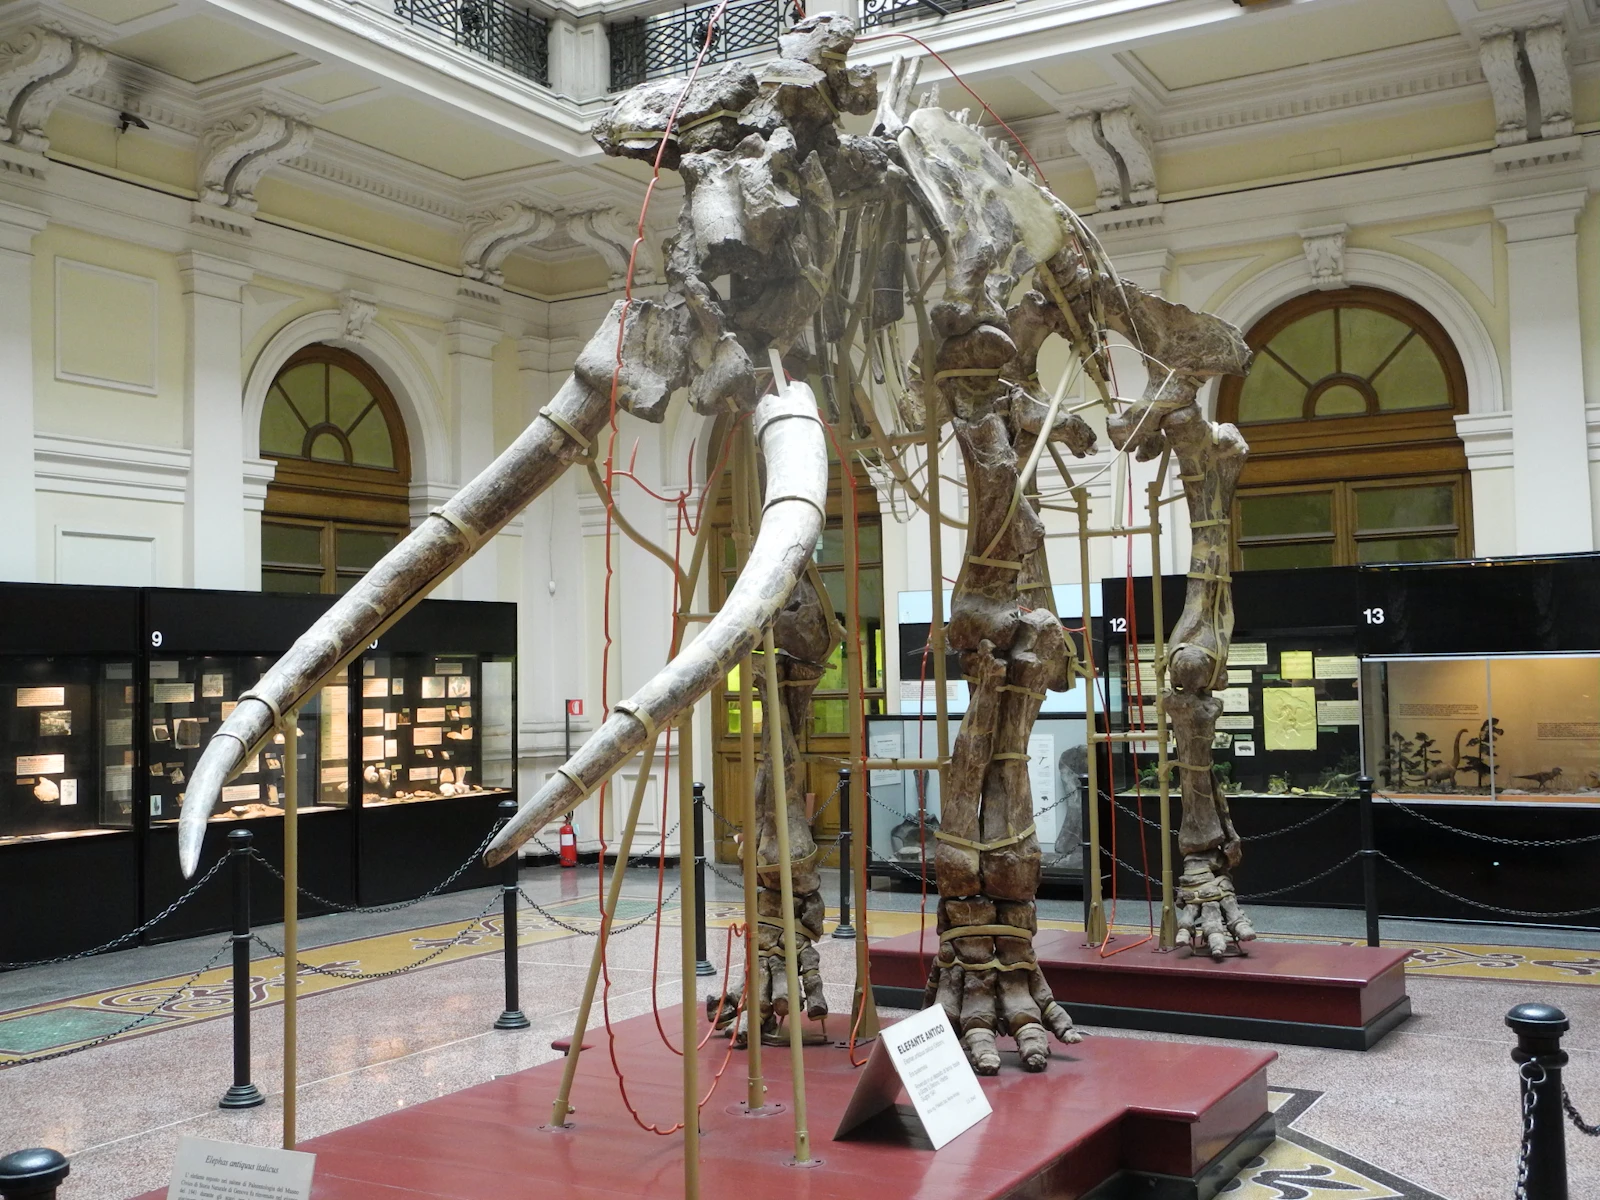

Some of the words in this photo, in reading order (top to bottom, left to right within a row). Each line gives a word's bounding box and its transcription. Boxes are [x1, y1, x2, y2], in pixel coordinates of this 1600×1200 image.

[1363, 608, 1384, 624] 13
[1109, 617, 1127, 632] 12
[152, 631, 162, 647] 9
[897, 1034, 926, 1055] ELEFANTE
[925, 1024, 945, 1040] ANTICO
[205, 1155, 228, 1166] Elephas
[229, 1161, 255, 1170] antiquus
[256, 1163, 279, 1173] italicus
